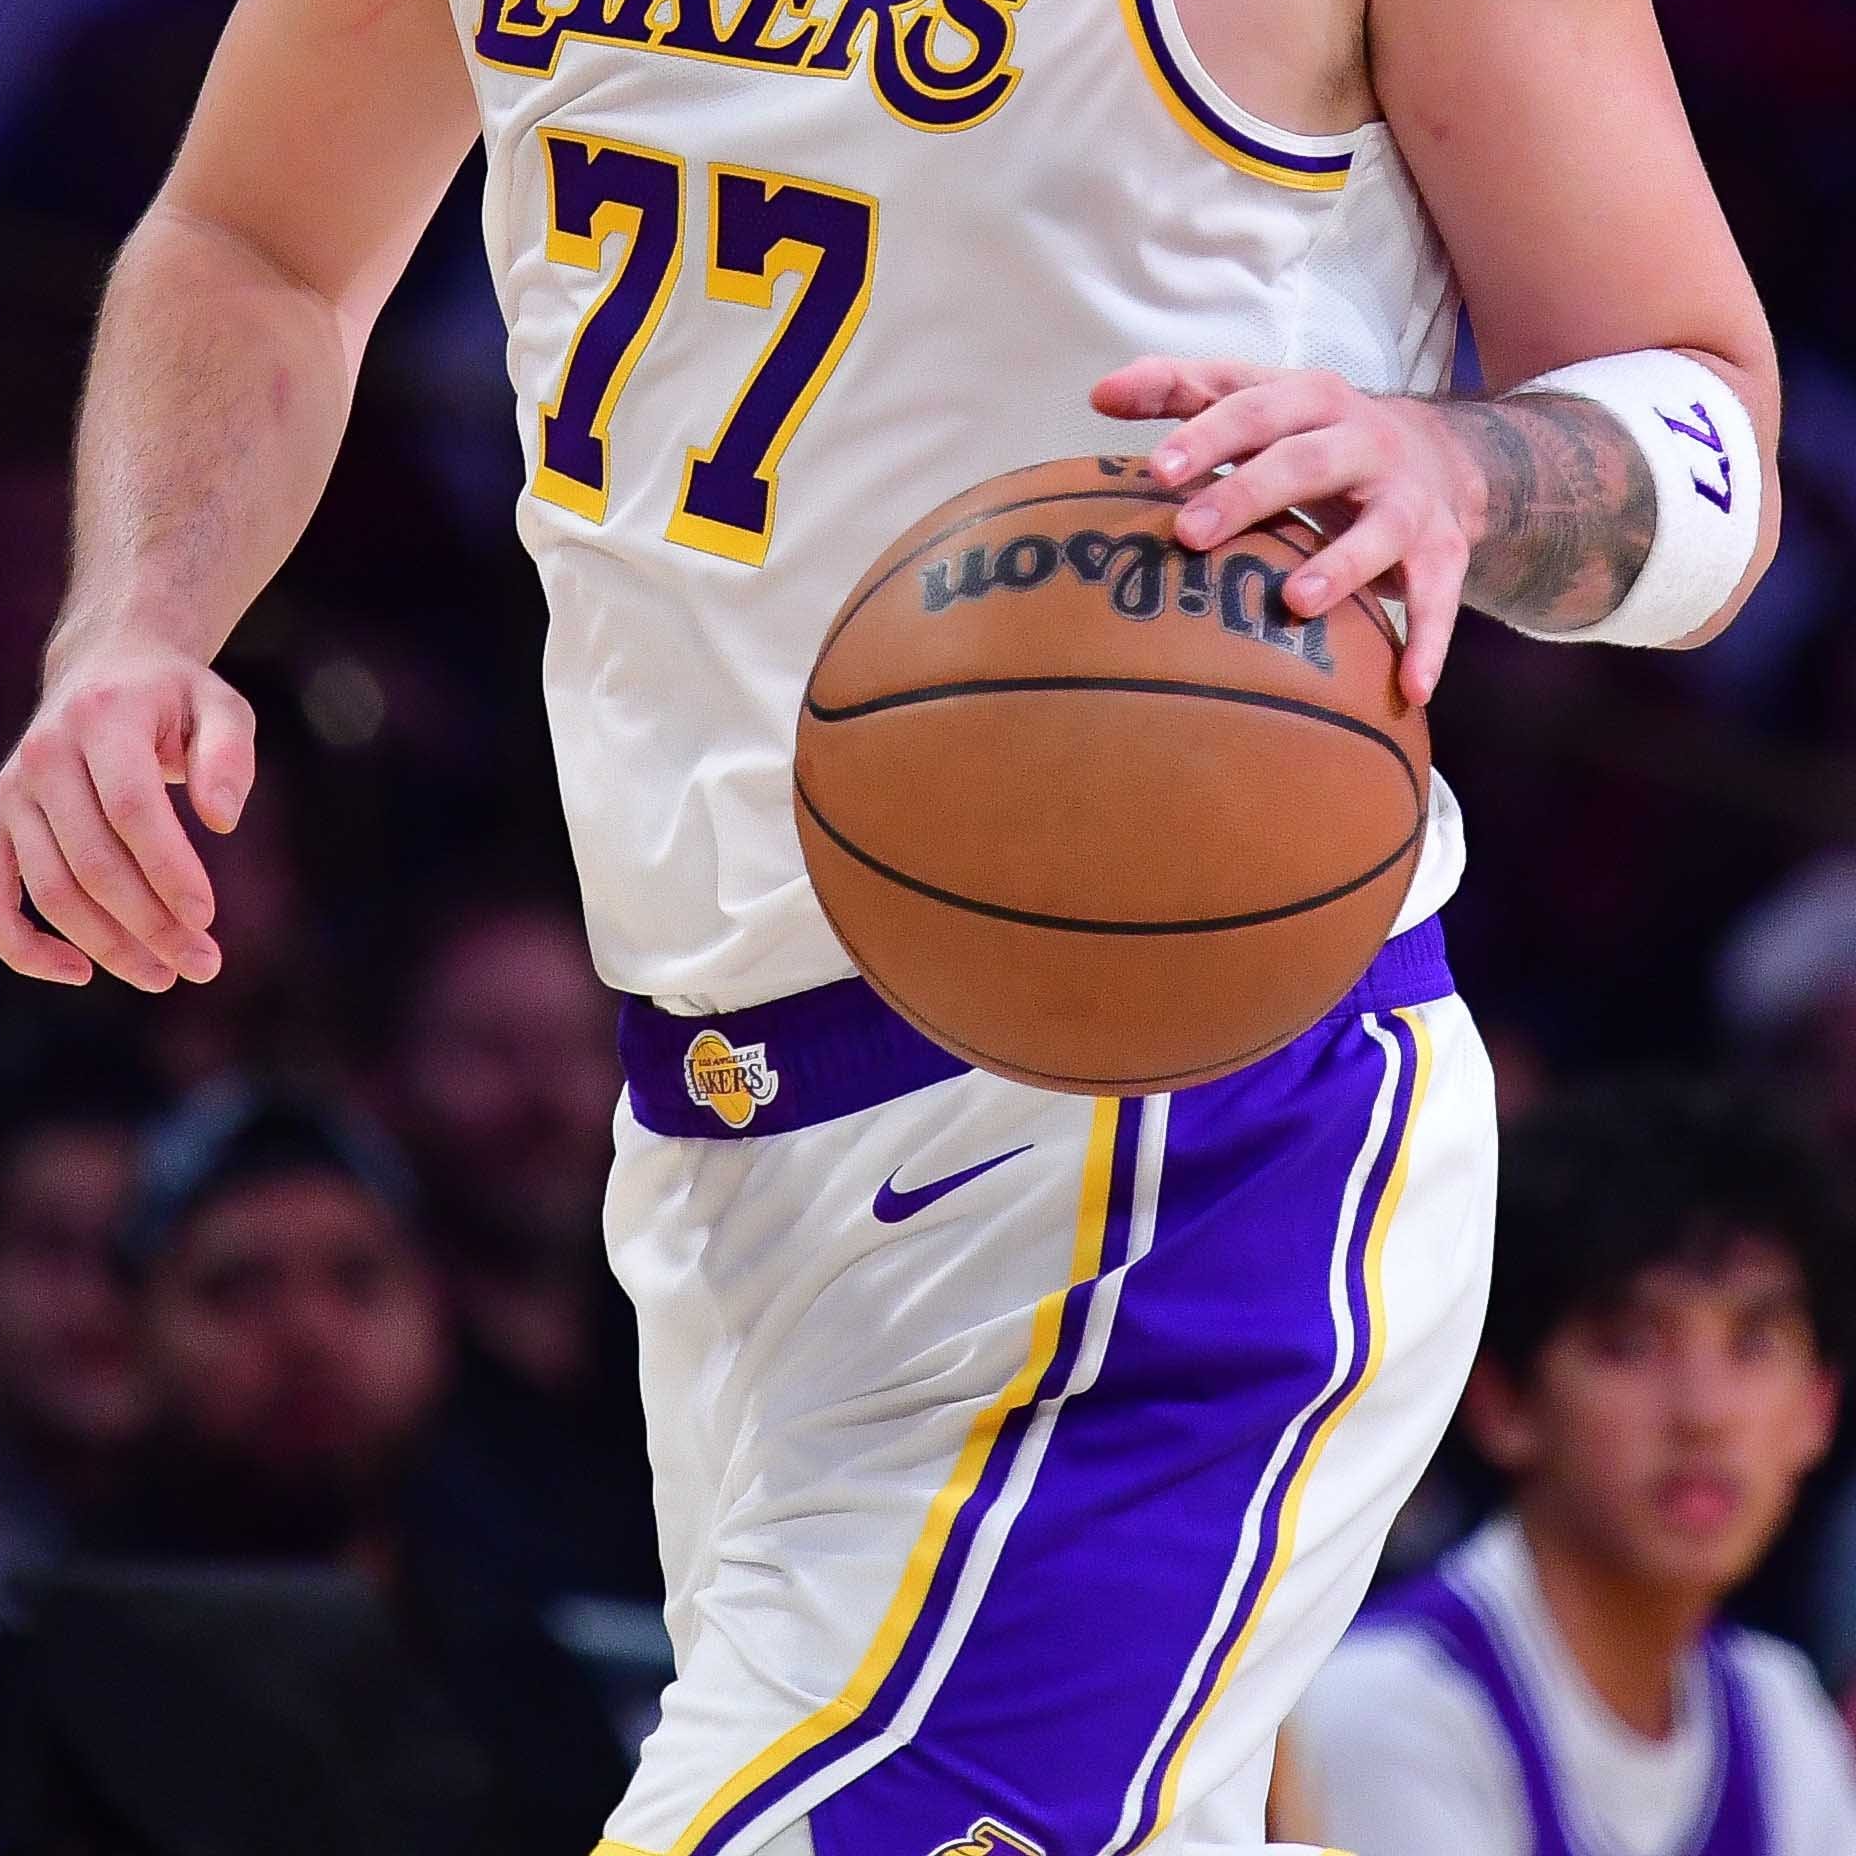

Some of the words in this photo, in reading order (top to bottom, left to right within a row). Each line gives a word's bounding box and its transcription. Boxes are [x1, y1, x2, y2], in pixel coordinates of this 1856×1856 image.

[530, 126, 880, 568] 77
[918, 528, 1336, 678] Wilson
[686, 1059, 774, 1101] LAKERS
